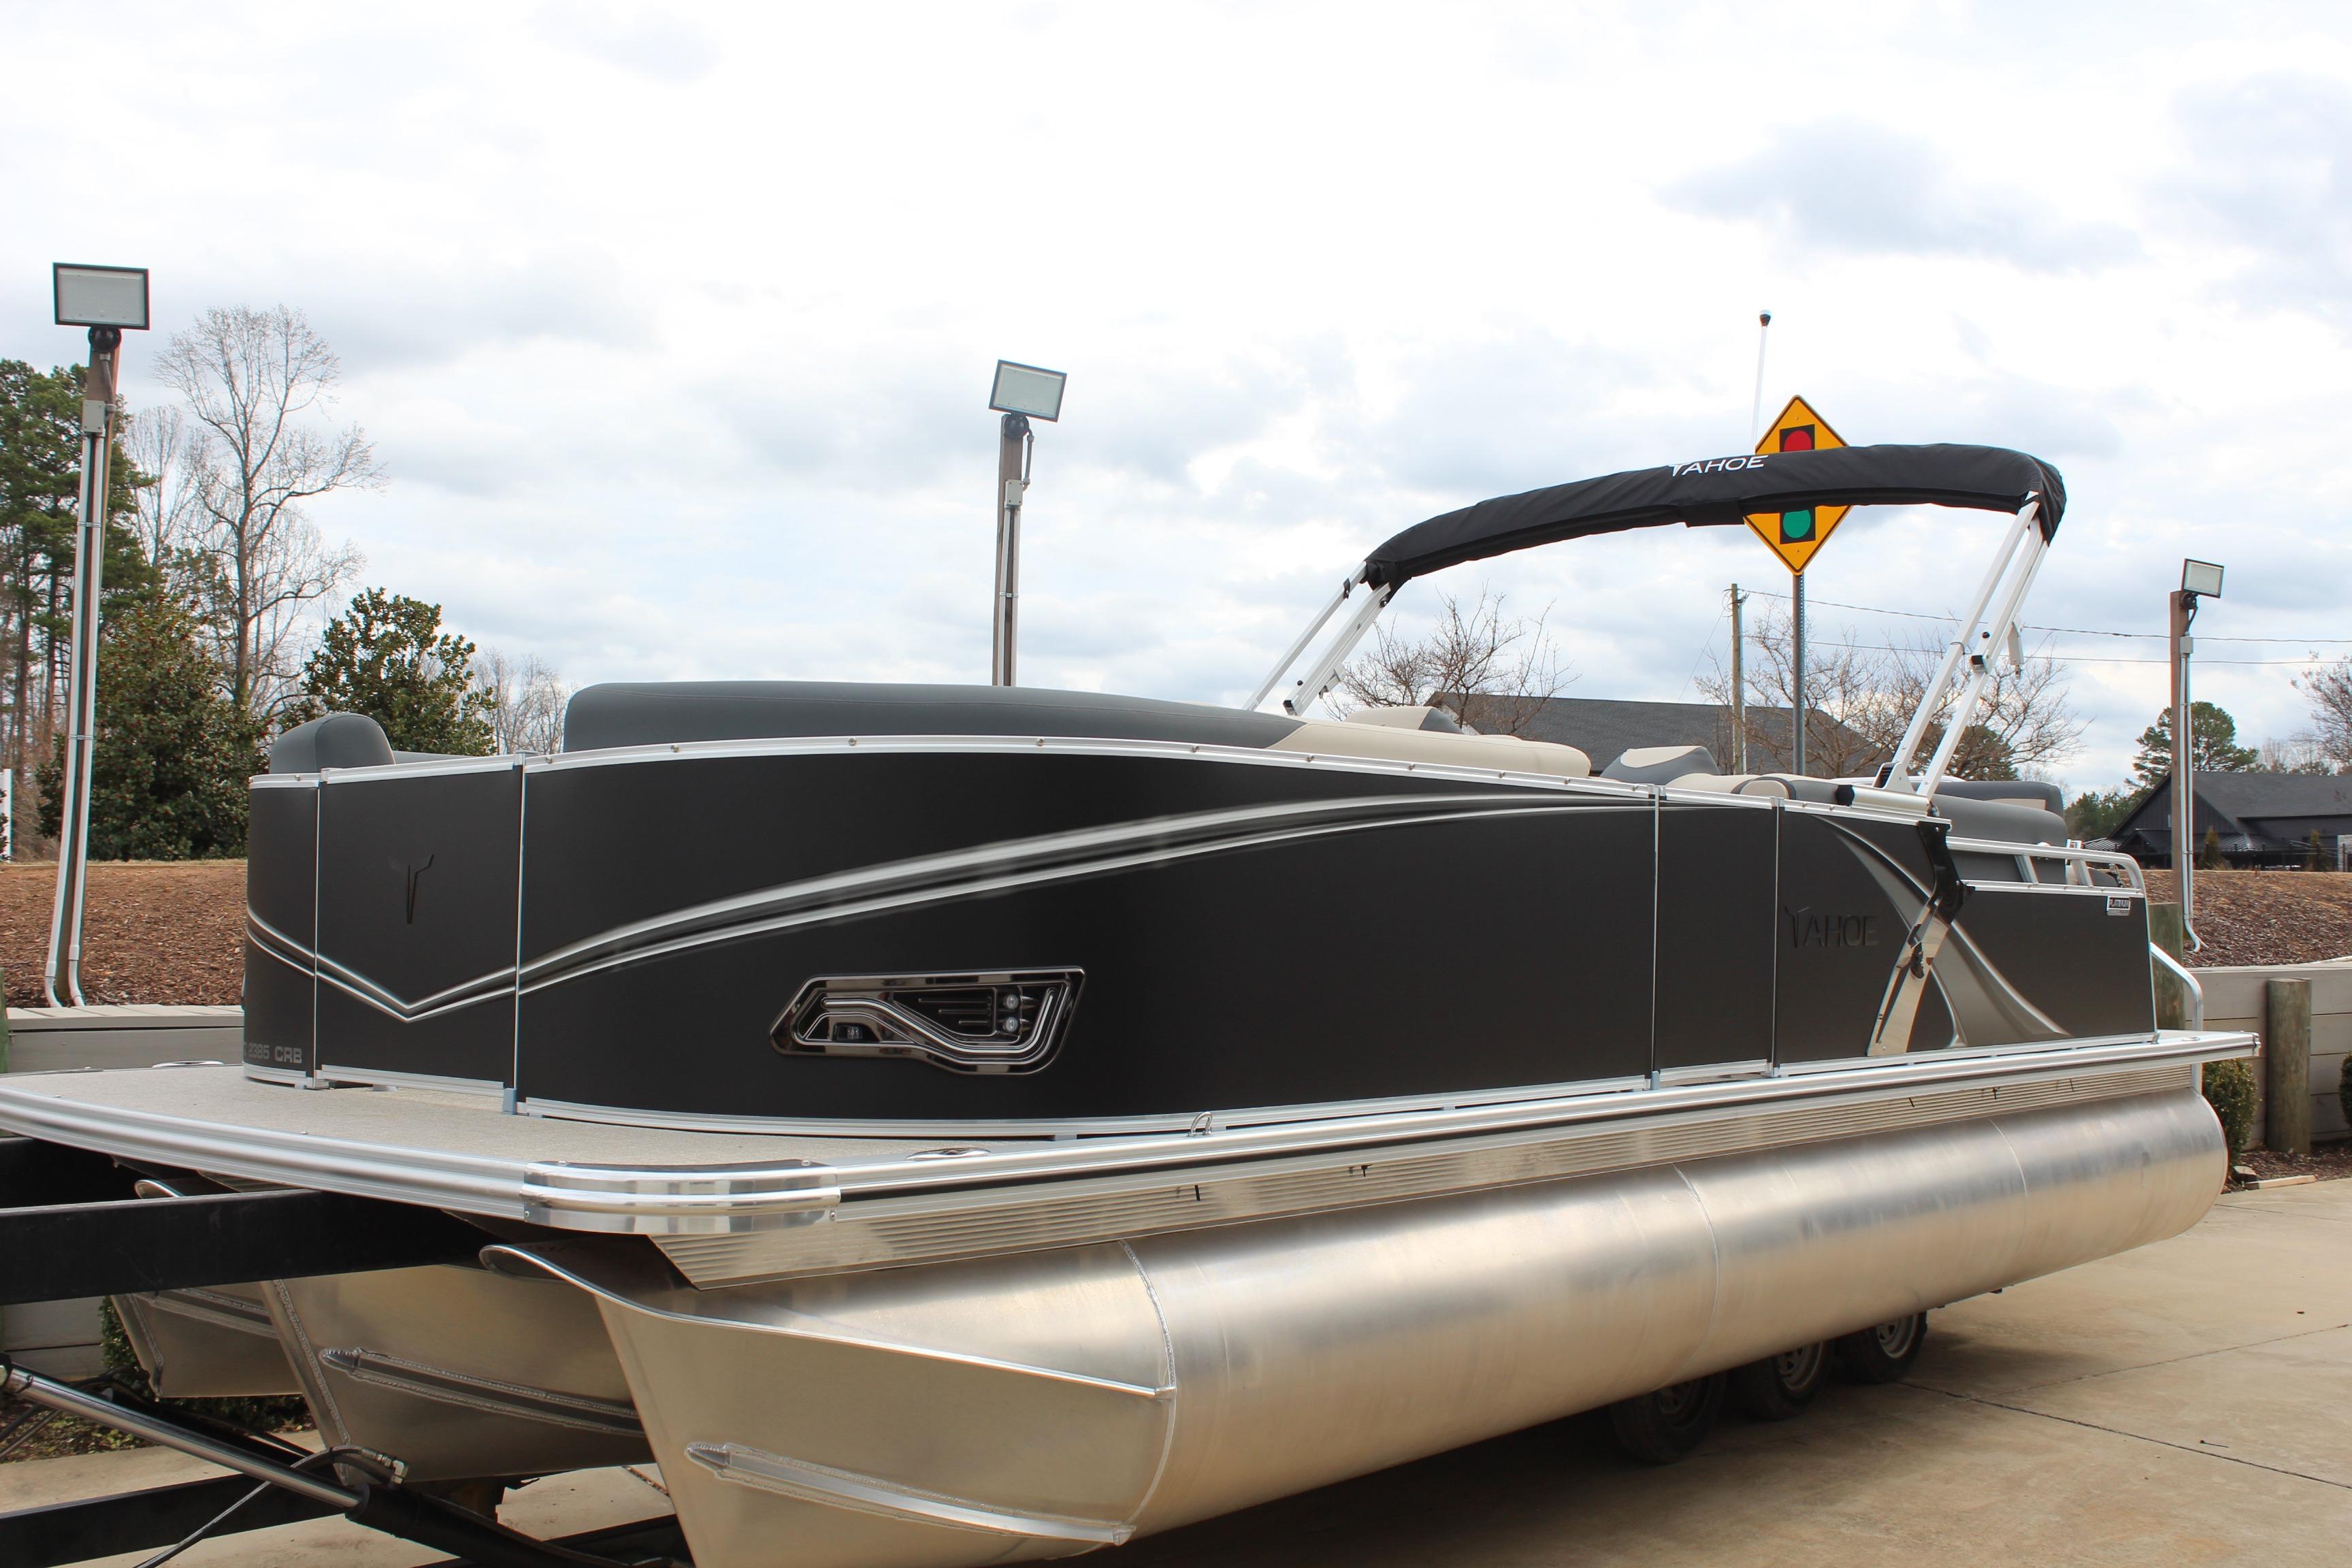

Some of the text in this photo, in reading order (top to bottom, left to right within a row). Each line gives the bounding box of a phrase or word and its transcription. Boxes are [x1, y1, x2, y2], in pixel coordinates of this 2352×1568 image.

[1669, 455, 1769, 477] TAHOE
[1784, 904, 1879, 948] TAHOE
[248, 1043, 270, 1060] 2385
[274, 1045, 303, 1064] CRB
